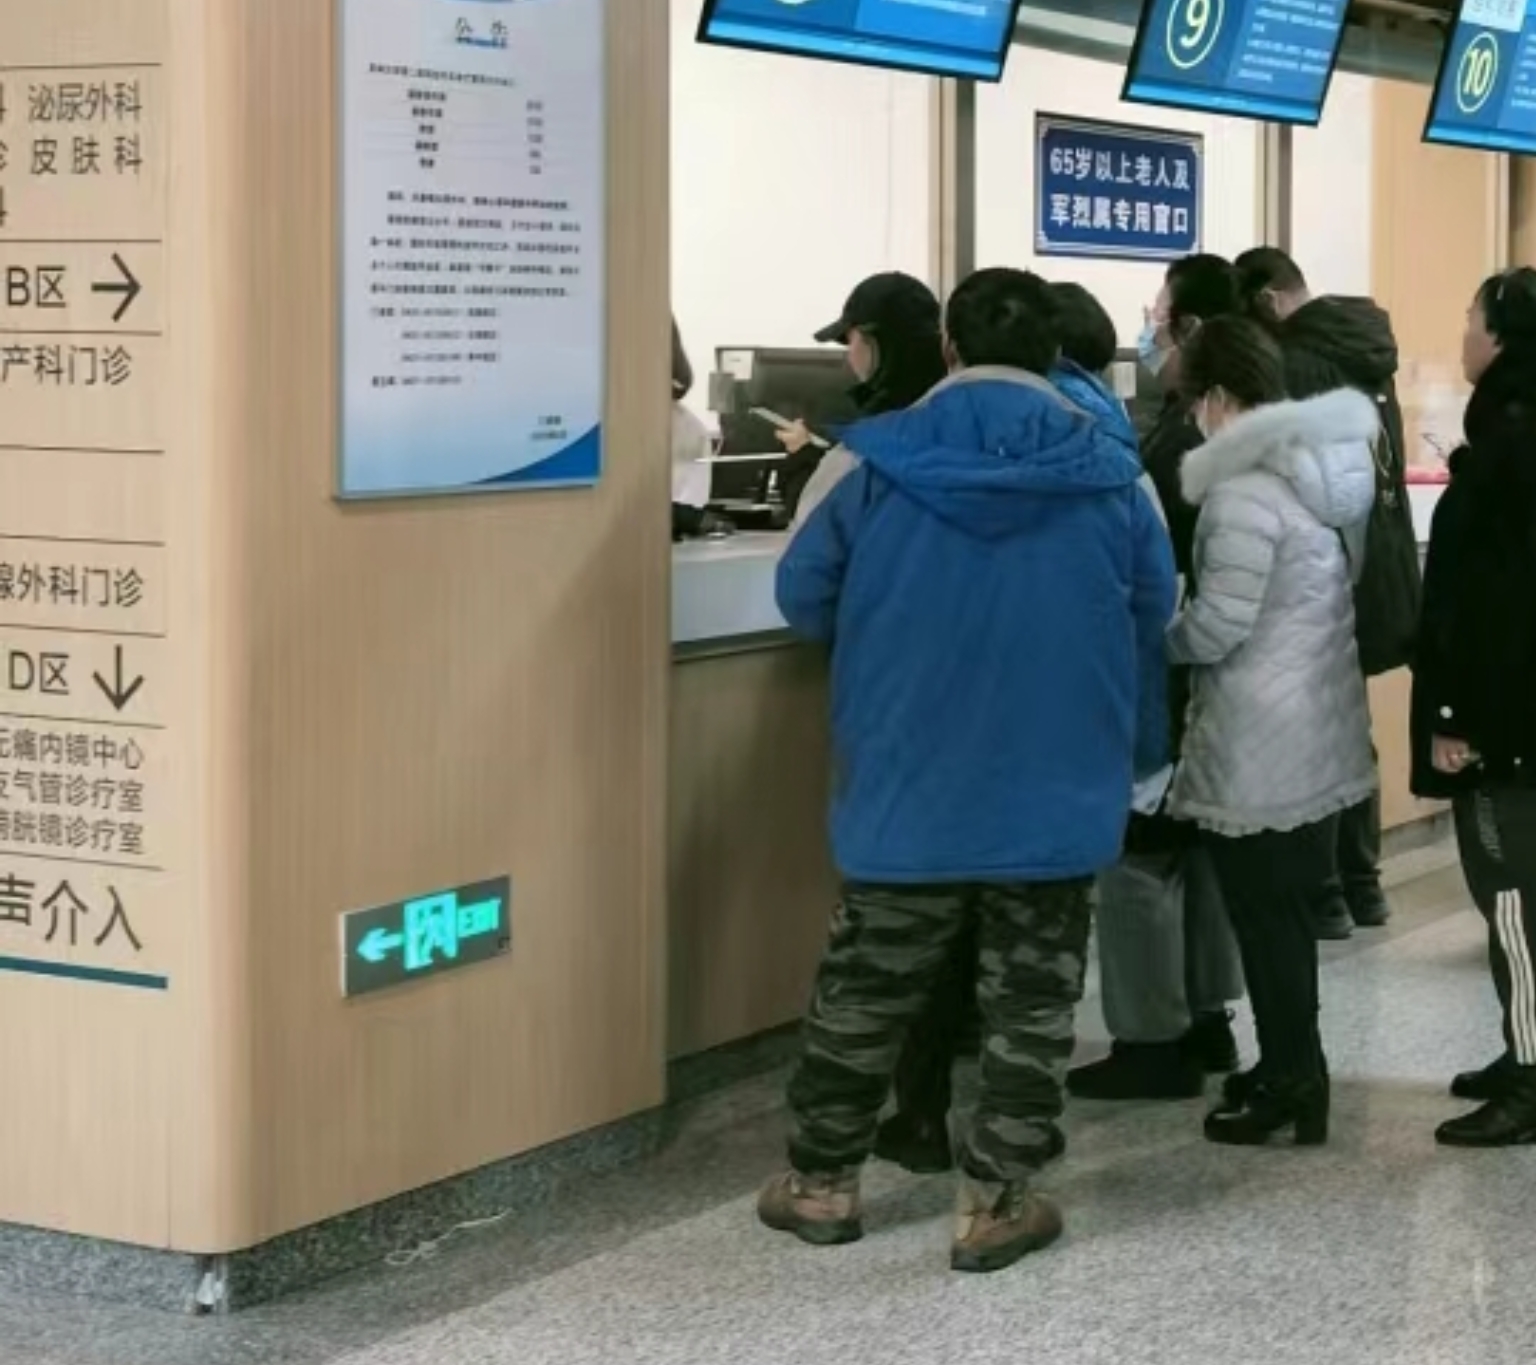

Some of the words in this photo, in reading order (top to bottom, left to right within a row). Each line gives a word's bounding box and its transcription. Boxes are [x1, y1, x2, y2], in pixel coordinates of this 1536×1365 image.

[1179, 0, 1209, 48] 9
[1463, 48, 1493, 96] 10
[28, 81, 142, 122] 泌尿外科
[30, 134, 143, 175] 皮肤科
[1050, 146, 1190, 191] 65岁以上老人及
[7, 265, 67, 308] B区
[9, 650, 69, 695] D区
